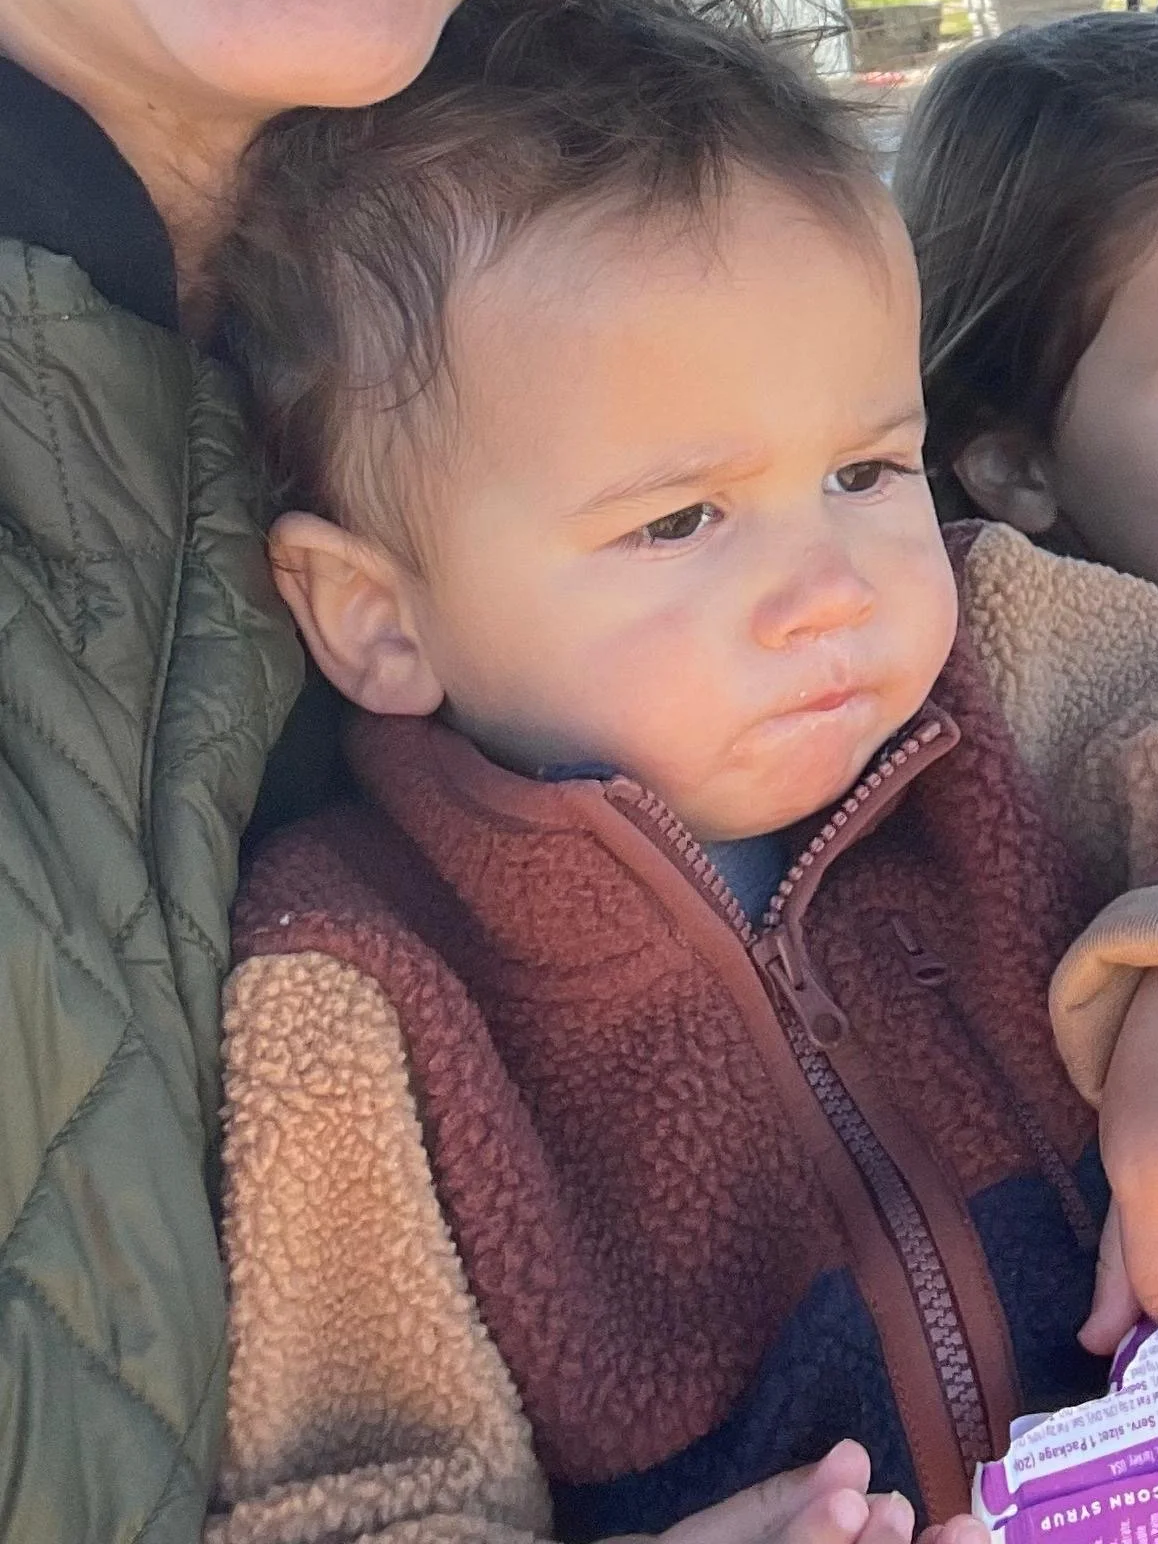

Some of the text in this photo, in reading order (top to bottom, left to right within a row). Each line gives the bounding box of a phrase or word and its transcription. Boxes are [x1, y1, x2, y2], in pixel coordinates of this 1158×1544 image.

[1126, 1415, 1156, 1432] Serv.
[1099, 1426, 1125, 1443] size:
[1039, 1439, 1087, 1463] Package
[1040, 1501, 1102, 1531] SYRUP
